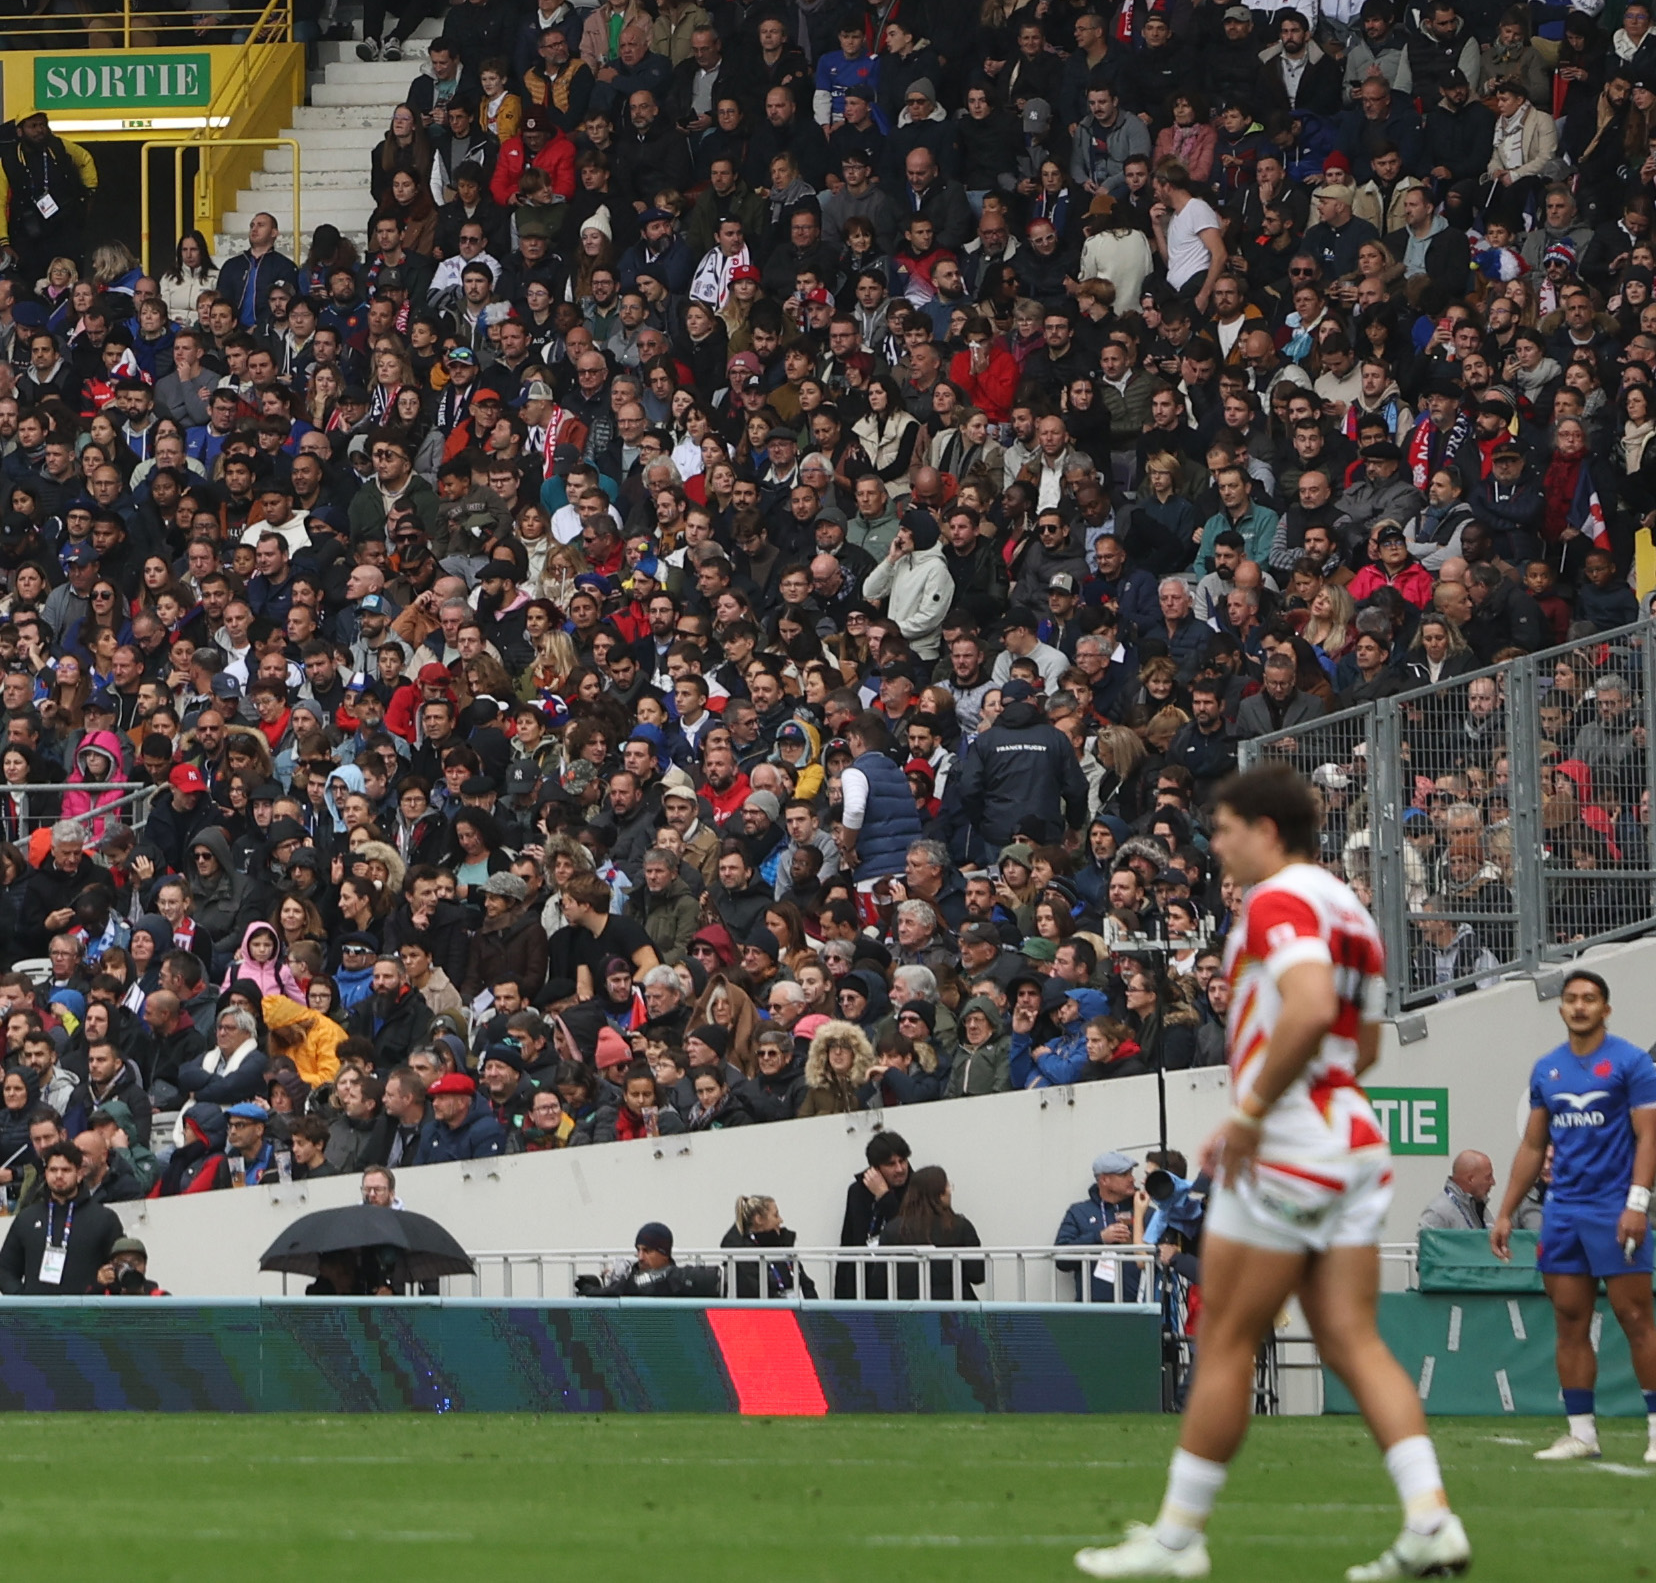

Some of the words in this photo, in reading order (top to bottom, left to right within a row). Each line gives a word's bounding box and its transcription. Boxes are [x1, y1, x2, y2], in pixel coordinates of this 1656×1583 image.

[46, 63, 199, 99] SORTIE
[1372, 1099, 1437, 1143] TIE
[1553, 1110, 1605, 1128] ALTRAD
